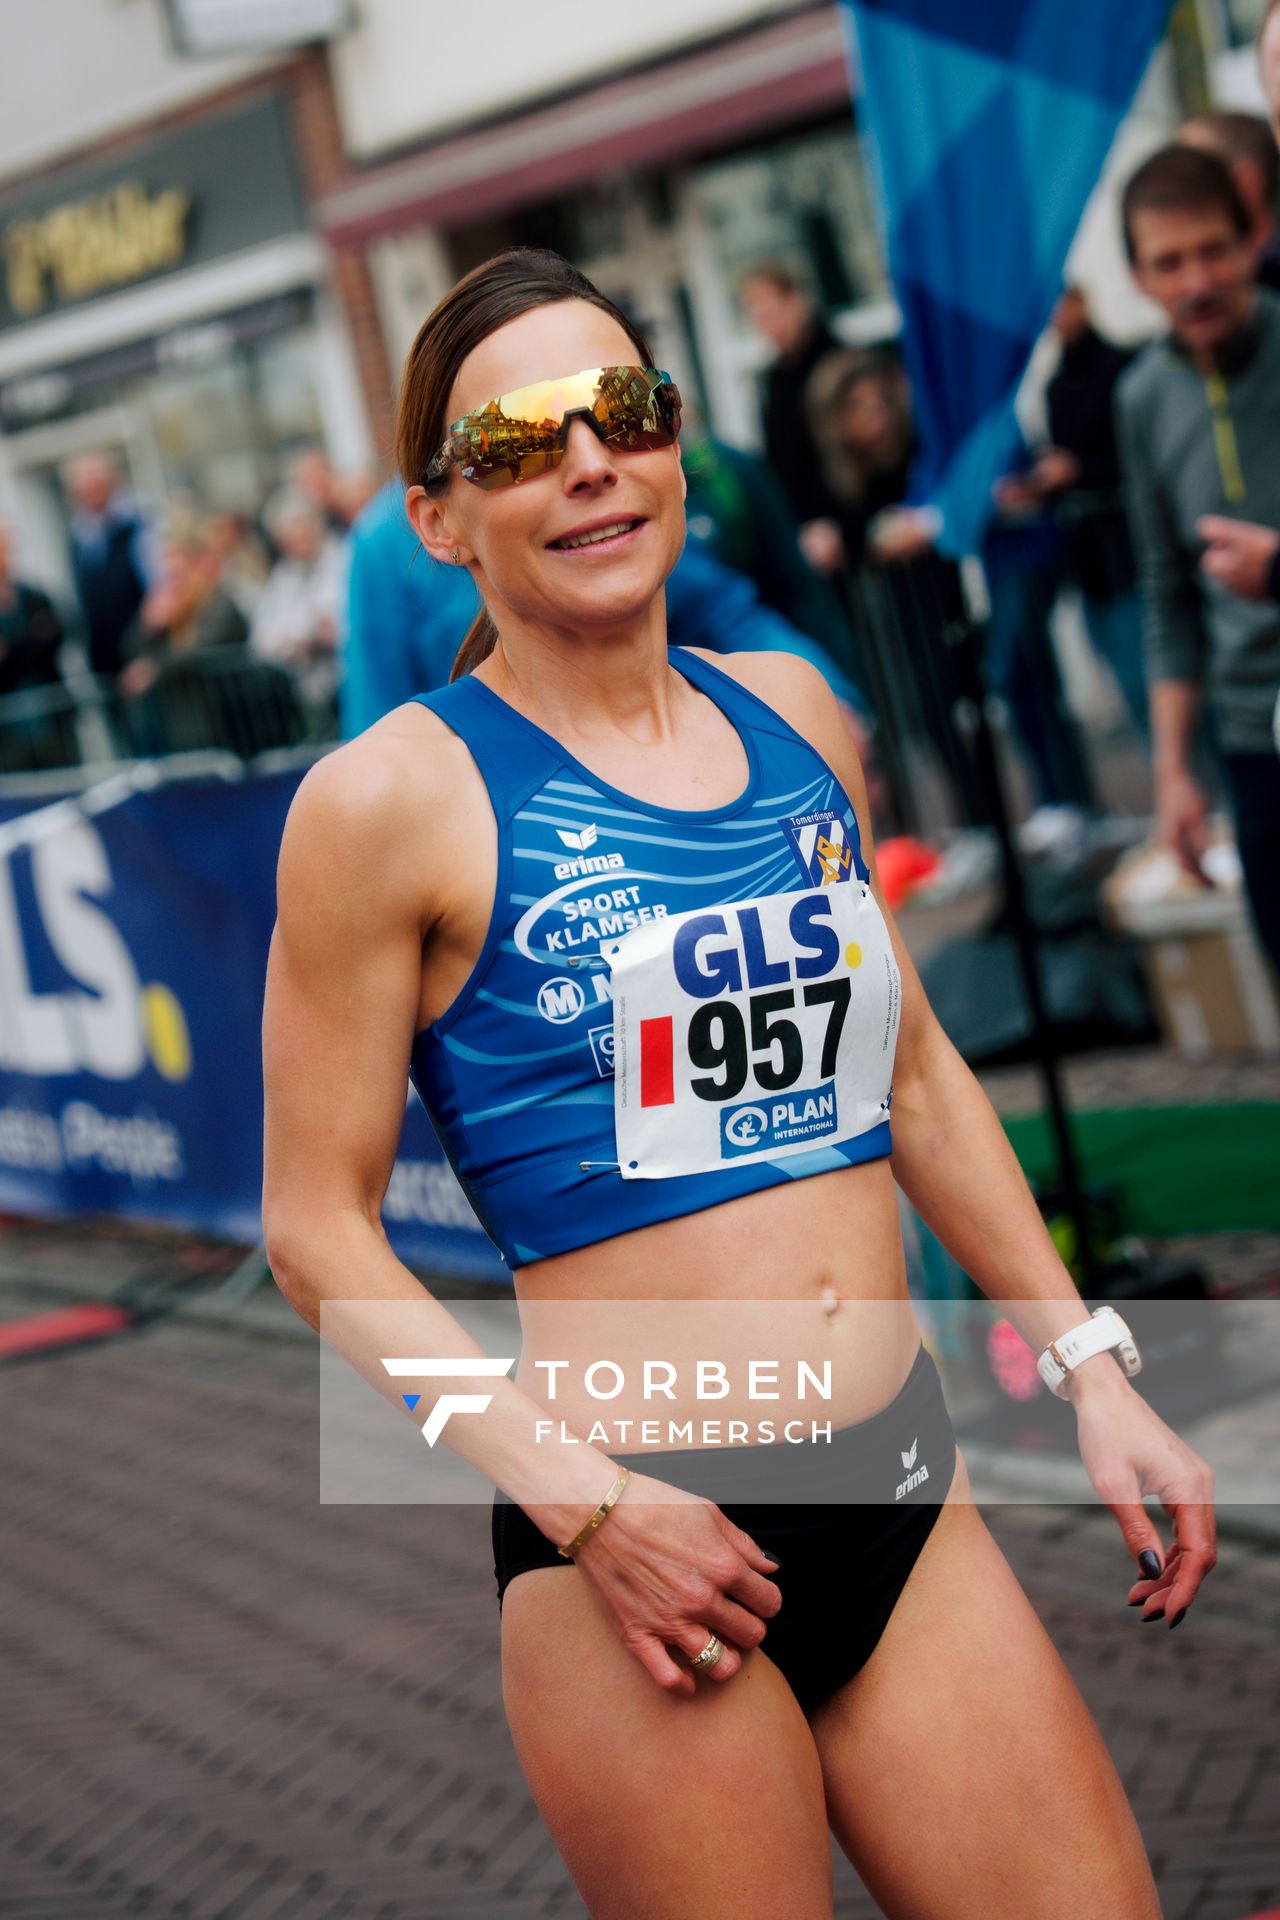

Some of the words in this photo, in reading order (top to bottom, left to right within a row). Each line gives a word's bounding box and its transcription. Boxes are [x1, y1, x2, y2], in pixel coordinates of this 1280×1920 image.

[554, 852, 625, 880] erima
[562, 886, 640, 922] SPORT
[545, 904, 669, 952] KLAMSER
[688, 977, 851, 1102] 957
[882, 1026, 891, 1051] Sabrina
[772, 1093, 833, 1128] PLAN
[774, 1120, 834, 1140] INTERNATIONAL
[896, 1464, 930, 1501] erima
